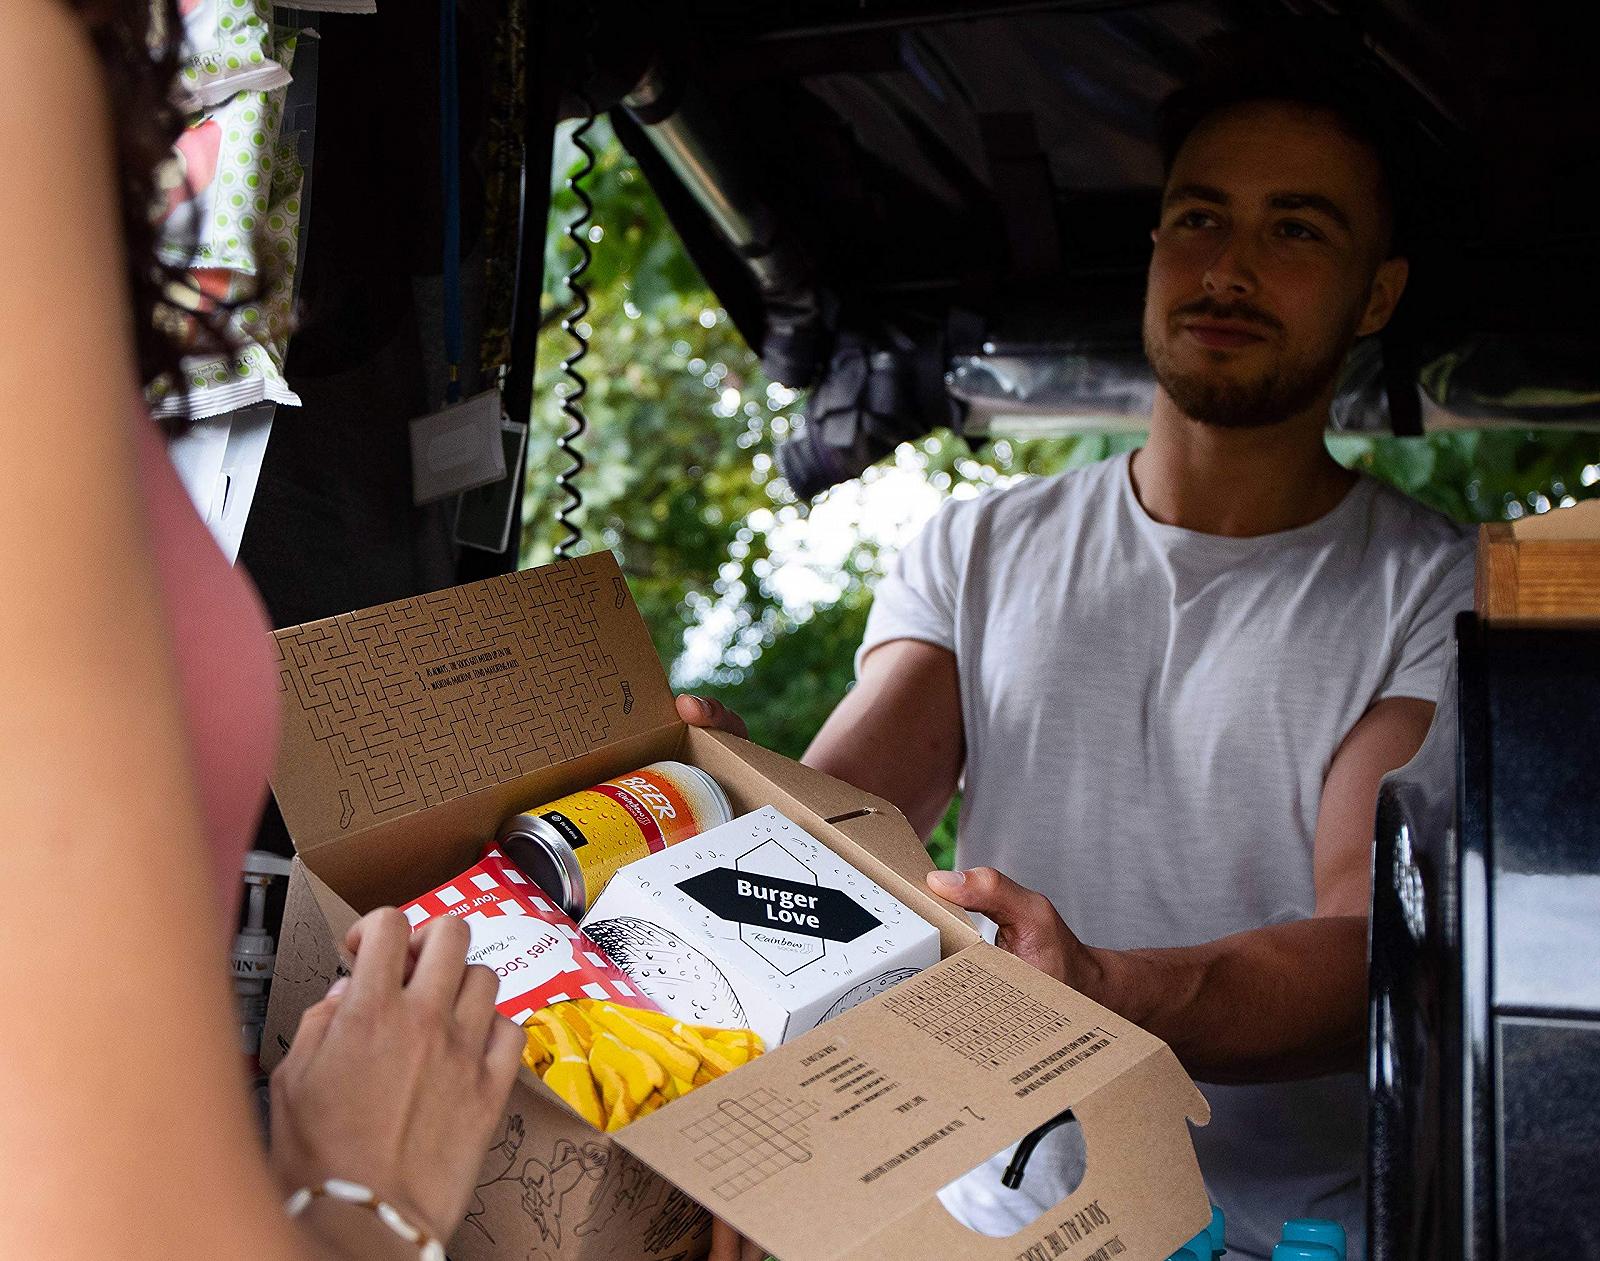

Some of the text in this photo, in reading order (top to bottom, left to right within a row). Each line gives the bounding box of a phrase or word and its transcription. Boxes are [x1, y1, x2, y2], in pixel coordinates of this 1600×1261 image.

[619, 776, 677, 820] BEER
[441, 893, 500, 918] Your stre
[737, 879, 818, 910] Burger
[766, 903, 820, 929] Love
[751, 931, 803, 950] Rainbow
[494, 933, 559, 982] Fries Soc
